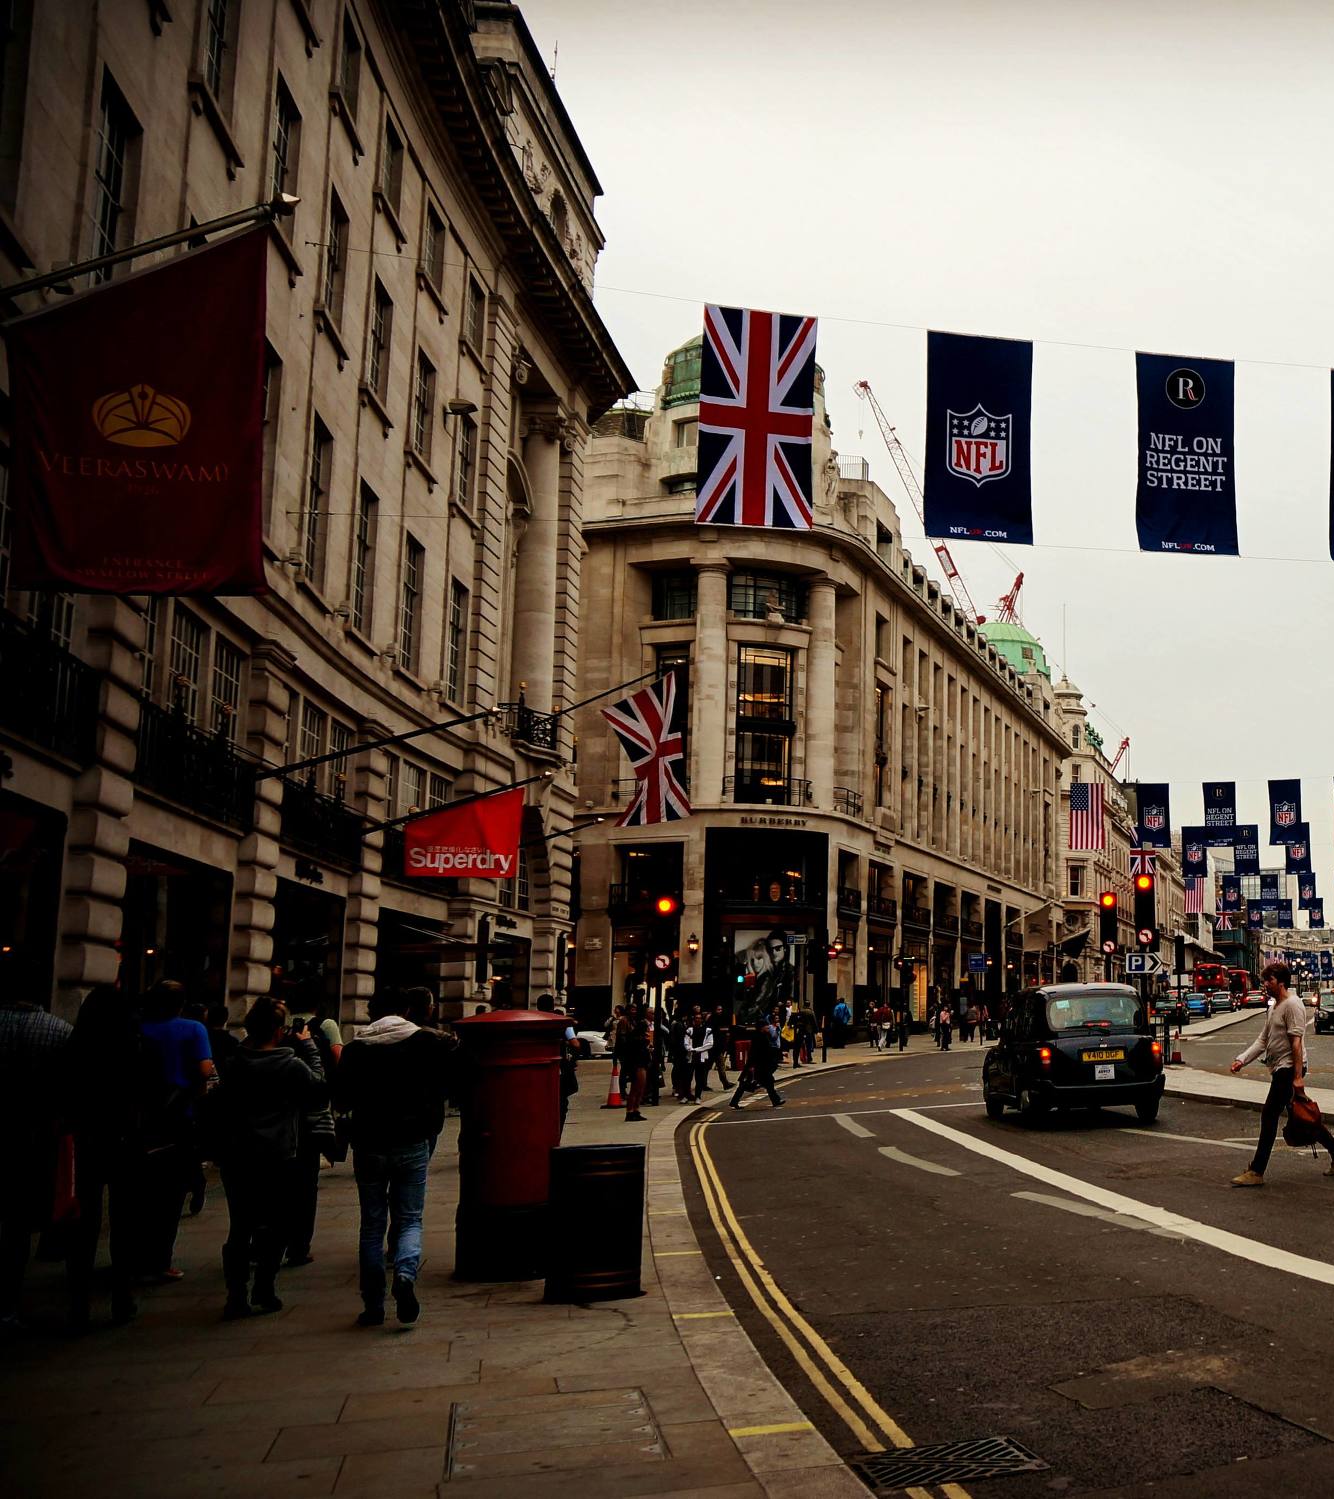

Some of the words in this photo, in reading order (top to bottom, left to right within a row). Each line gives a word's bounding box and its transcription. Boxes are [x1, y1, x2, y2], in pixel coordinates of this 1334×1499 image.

[1177, 377, 1198, 400] R
[1150, 432, 1188, 452] NFL
[1193, 437, 1222, 454] ON
[954, 439, 1004, 474] NFL
[1146, 451, 1227, 473] REGENT
[1146, 471, 1226, 491] STREET
[740, 816, 809, 827] BURBERRY
[1145, 816, 1163, 827] NFL
[1278, 812, 1293, 823] NFL
[409, 847, 513, 875] Superdry
[1187, 851, 1201, 861] NFL
